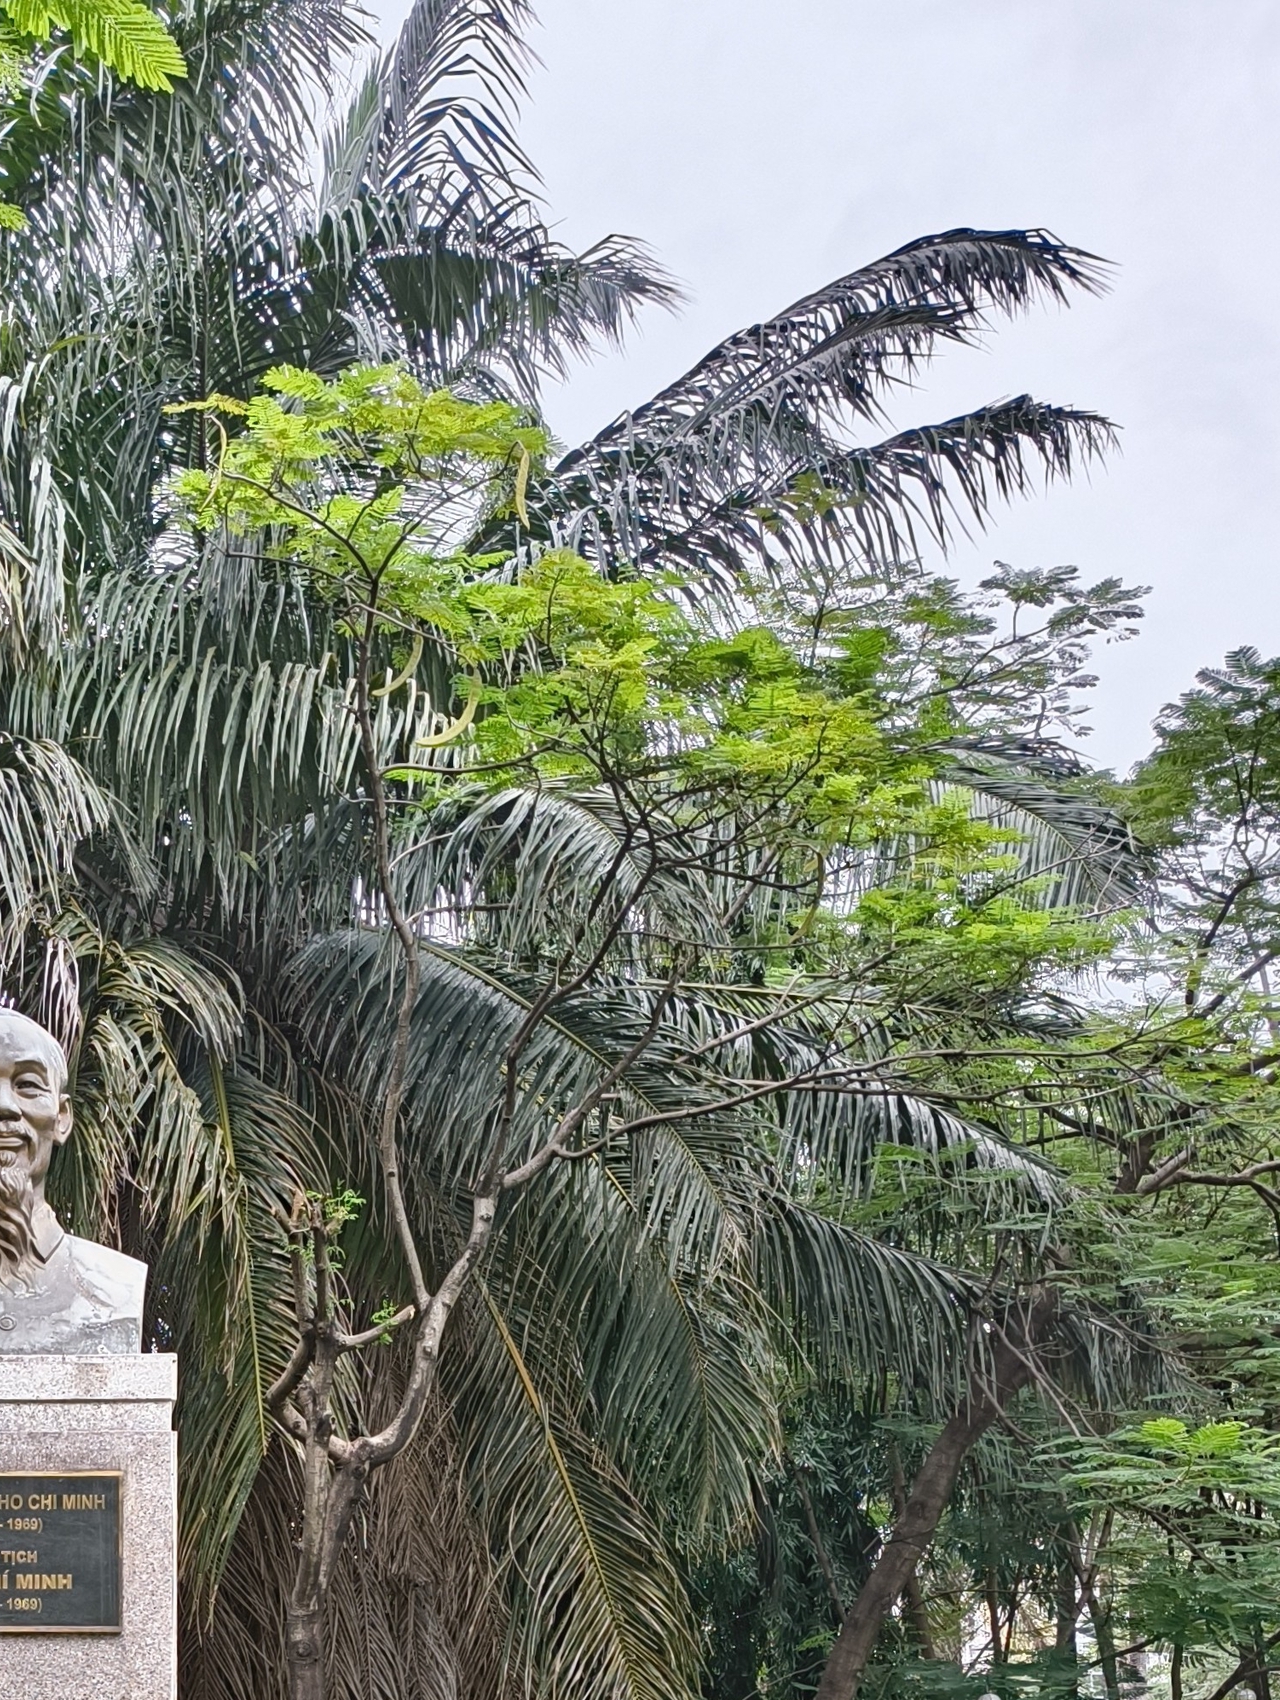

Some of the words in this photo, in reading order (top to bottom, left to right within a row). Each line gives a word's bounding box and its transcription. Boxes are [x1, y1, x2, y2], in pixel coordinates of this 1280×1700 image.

[28, 1494, 57, 1510] CHI
[62, 1494, 105, 1510] MINH
[6, 1518, 43, 1533] 1969)
[1, 1550, 38, 1566] TỊCH
[15, 1573, 73, 1590] MINH
[6, 1597, 43, 1613] 1969)
